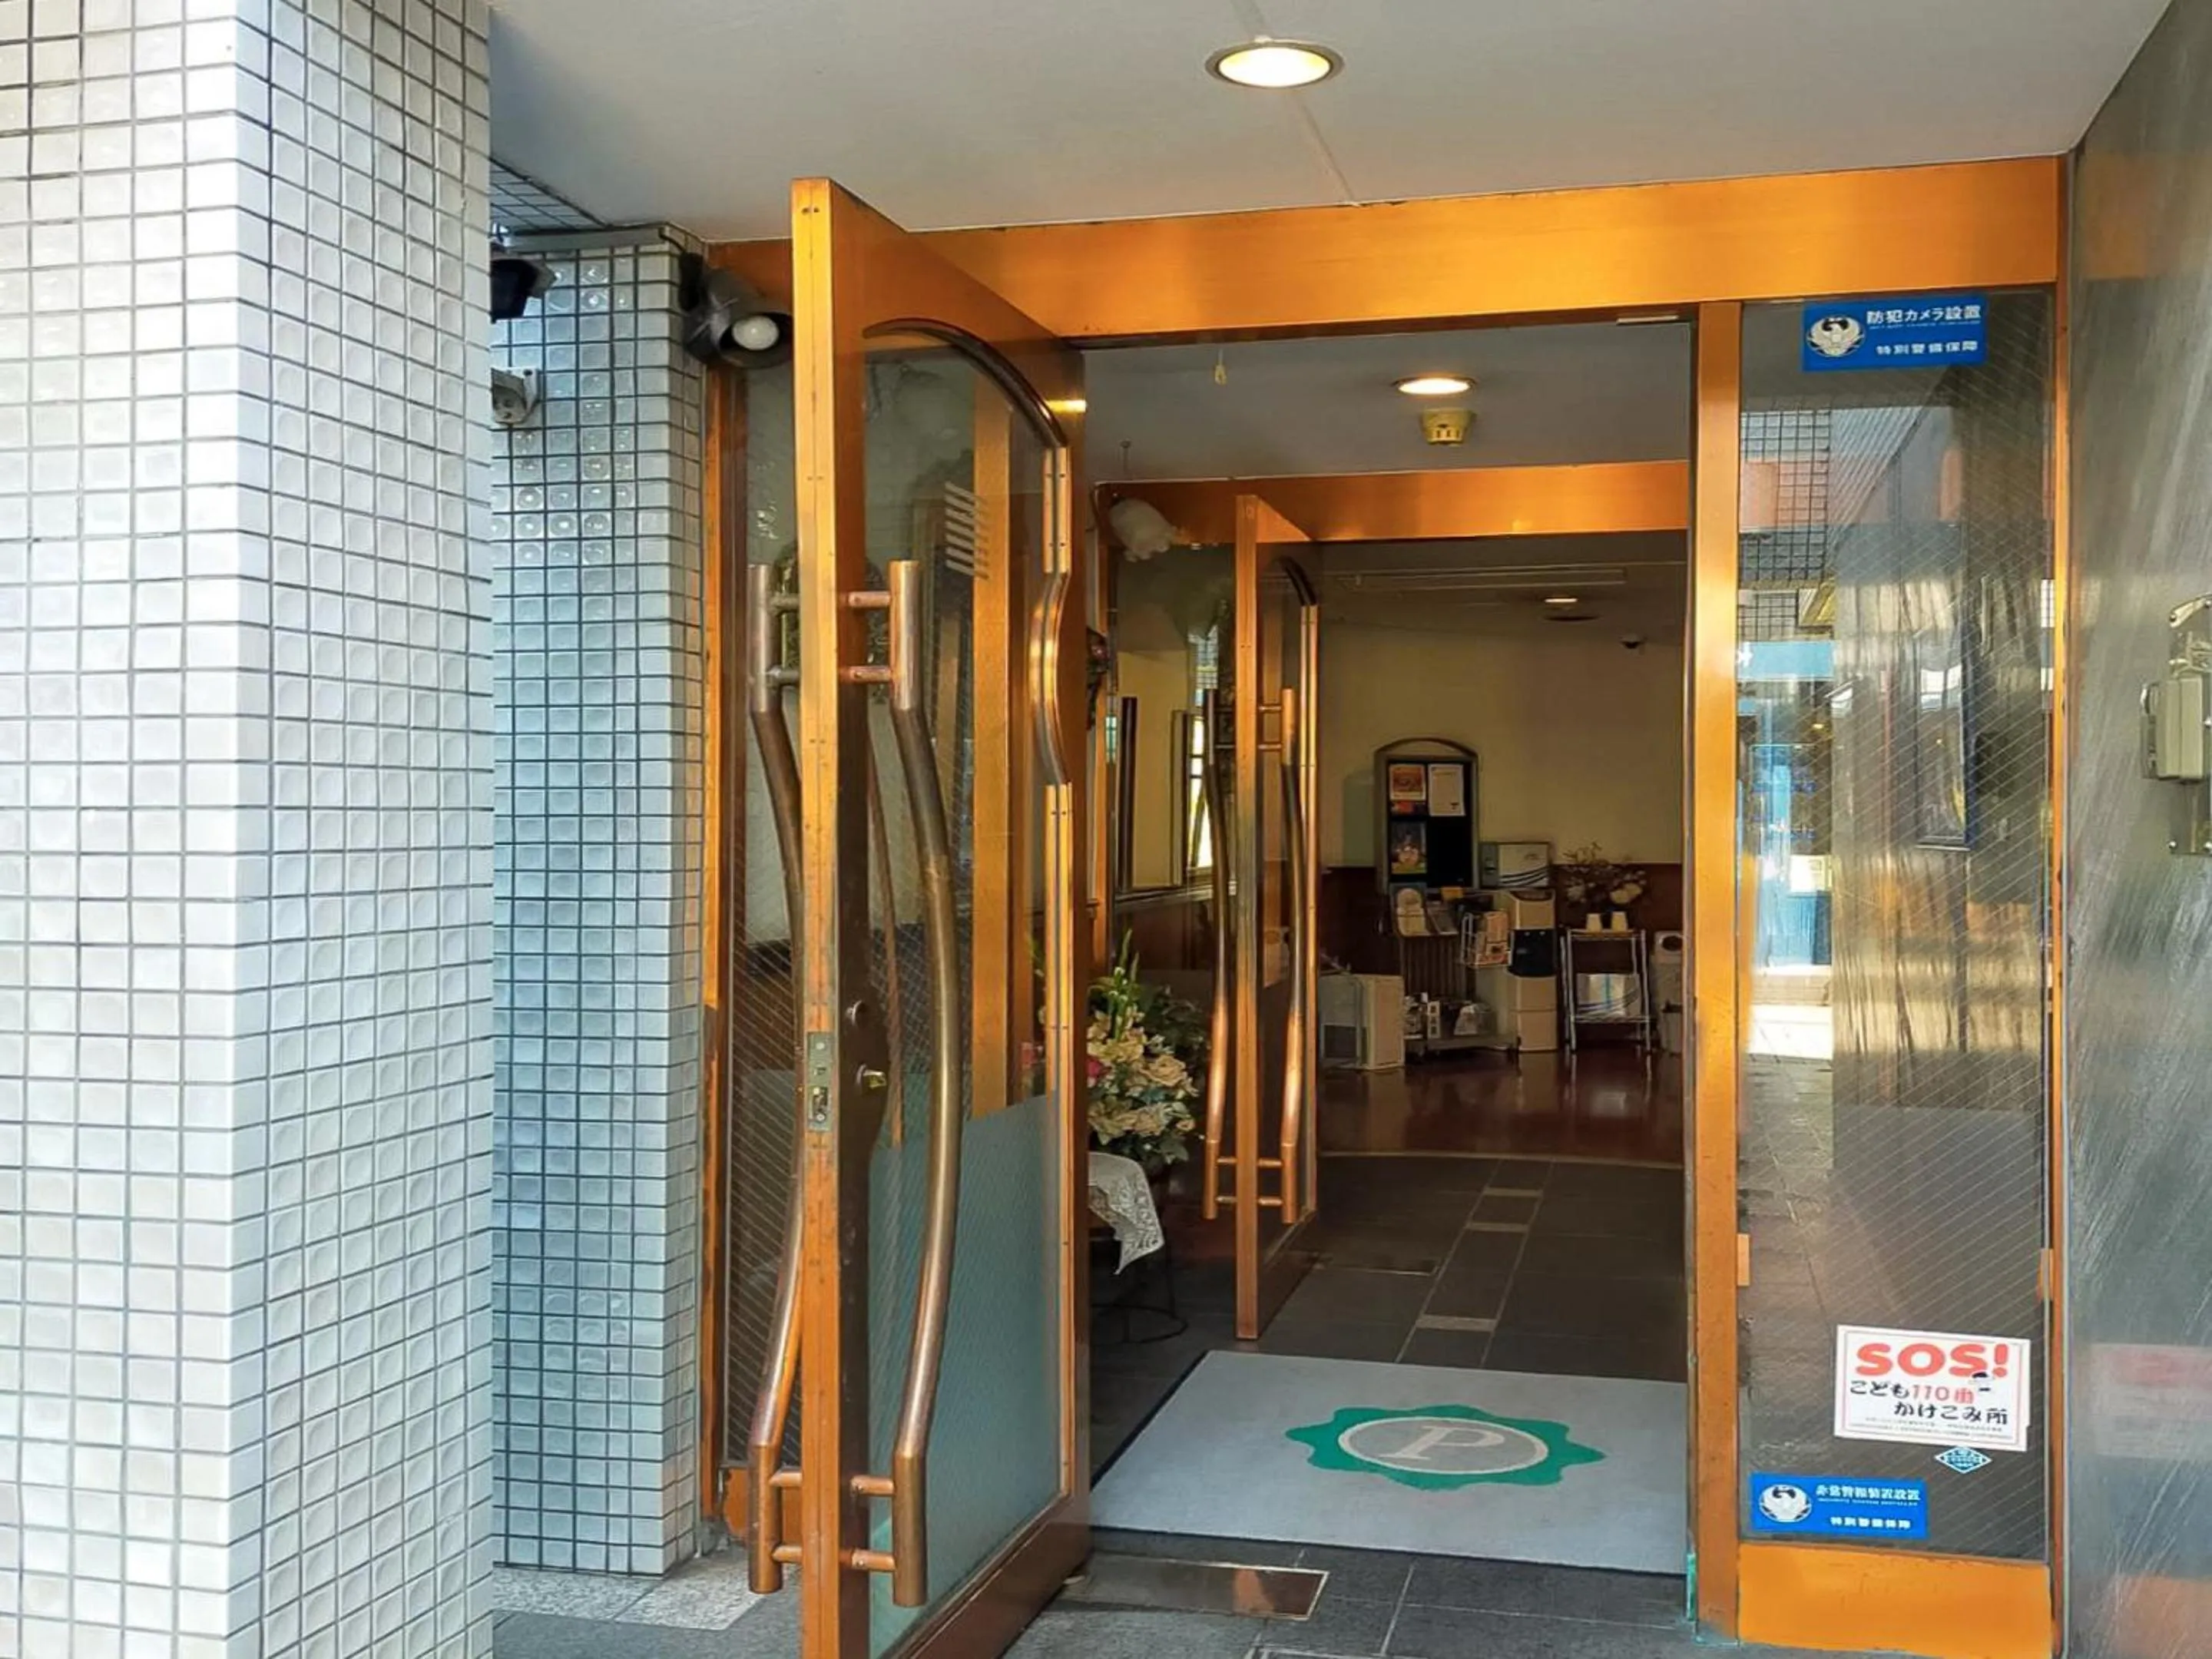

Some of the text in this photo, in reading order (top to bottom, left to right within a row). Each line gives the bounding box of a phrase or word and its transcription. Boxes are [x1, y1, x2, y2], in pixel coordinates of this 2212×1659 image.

[1866, 304, 1981, 324] 防犯カメラ設置
[1856, 1343, 2009, 1378] SOS!
[1894, 1402, 2008, 1425] かけこみ所
